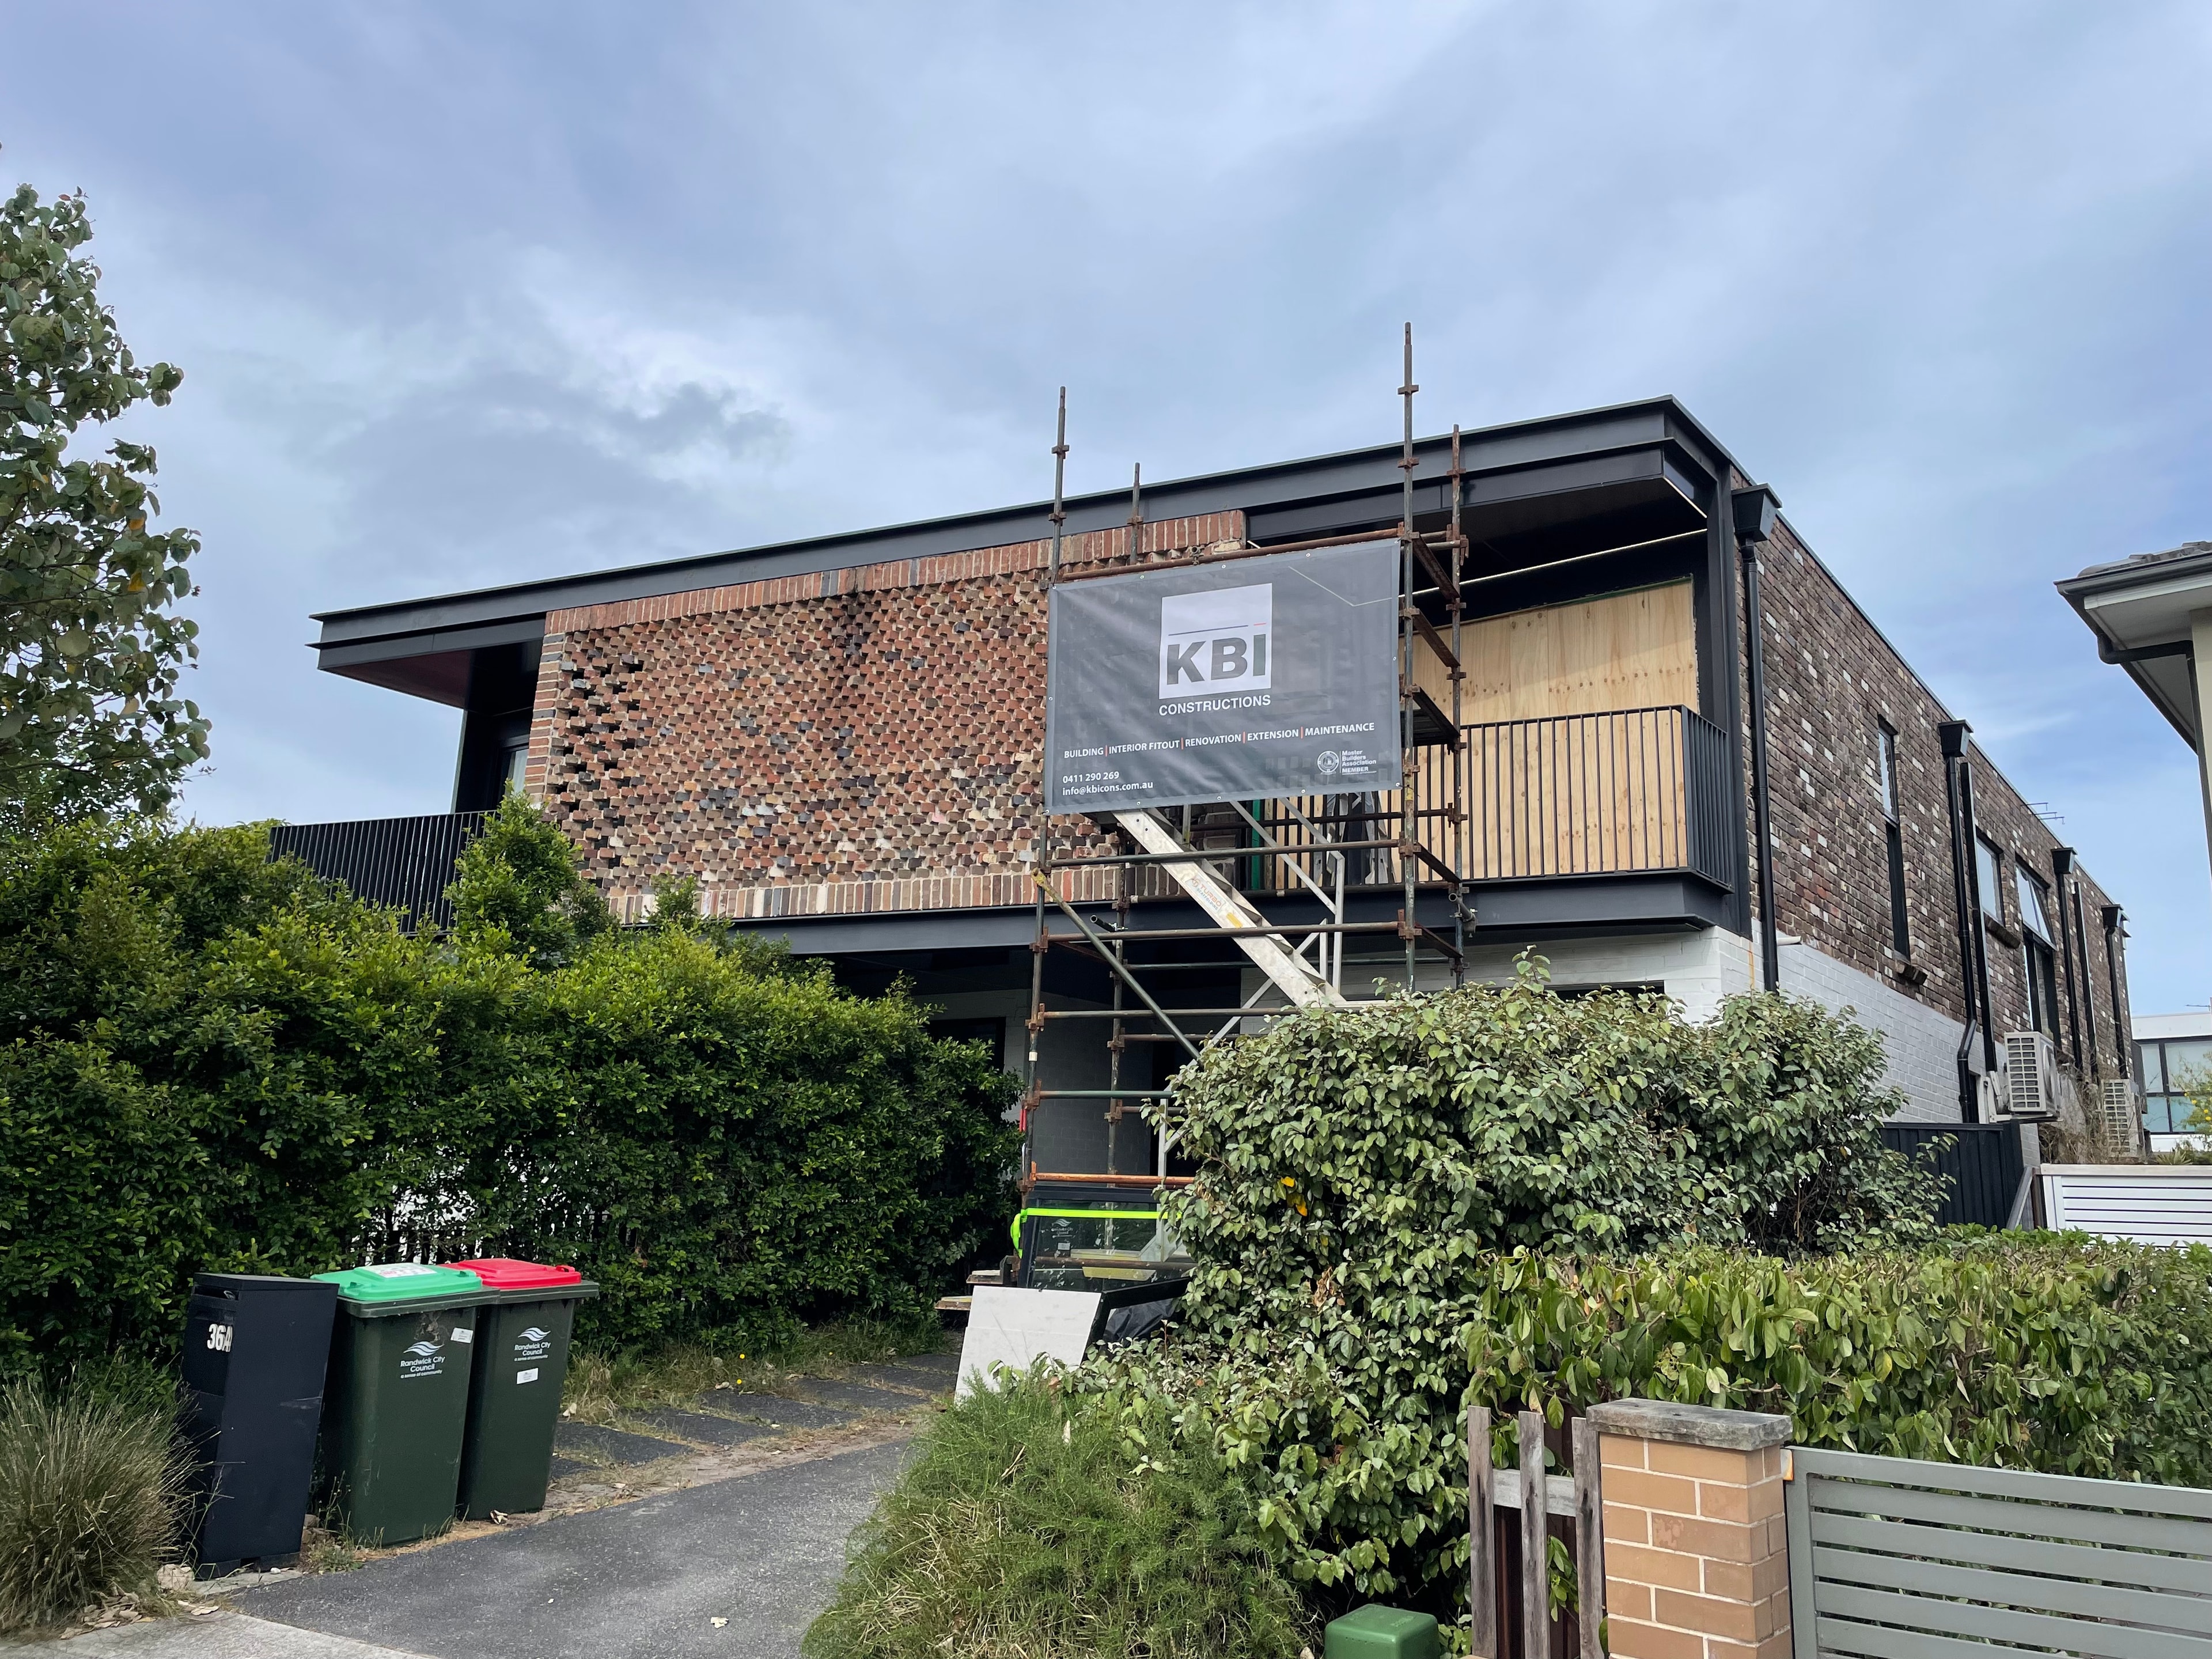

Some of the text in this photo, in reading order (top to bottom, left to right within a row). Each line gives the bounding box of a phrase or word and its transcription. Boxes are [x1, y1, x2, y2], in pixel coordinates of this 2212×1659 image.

[1166, 634, 1266, 685] KBI
[1158, 694, 1271, 716] CONSTRUCTIONS
[1064, 722, 1375, 759] BUILDING INTERIOR FITOUT RENOVATION EXTENSION MAINTENANCE
[1062, 771, 1120, 783] 0411 290 269
[1062, 781, 1153, 796] info@kbicons.com.au
[1200, 884, 1222, 907] TURBO
[207, 1324, 233, 1353] 36A
[400, 1358, 432, 1367] Randwick
[410, 1363, 435, 1372] Council
